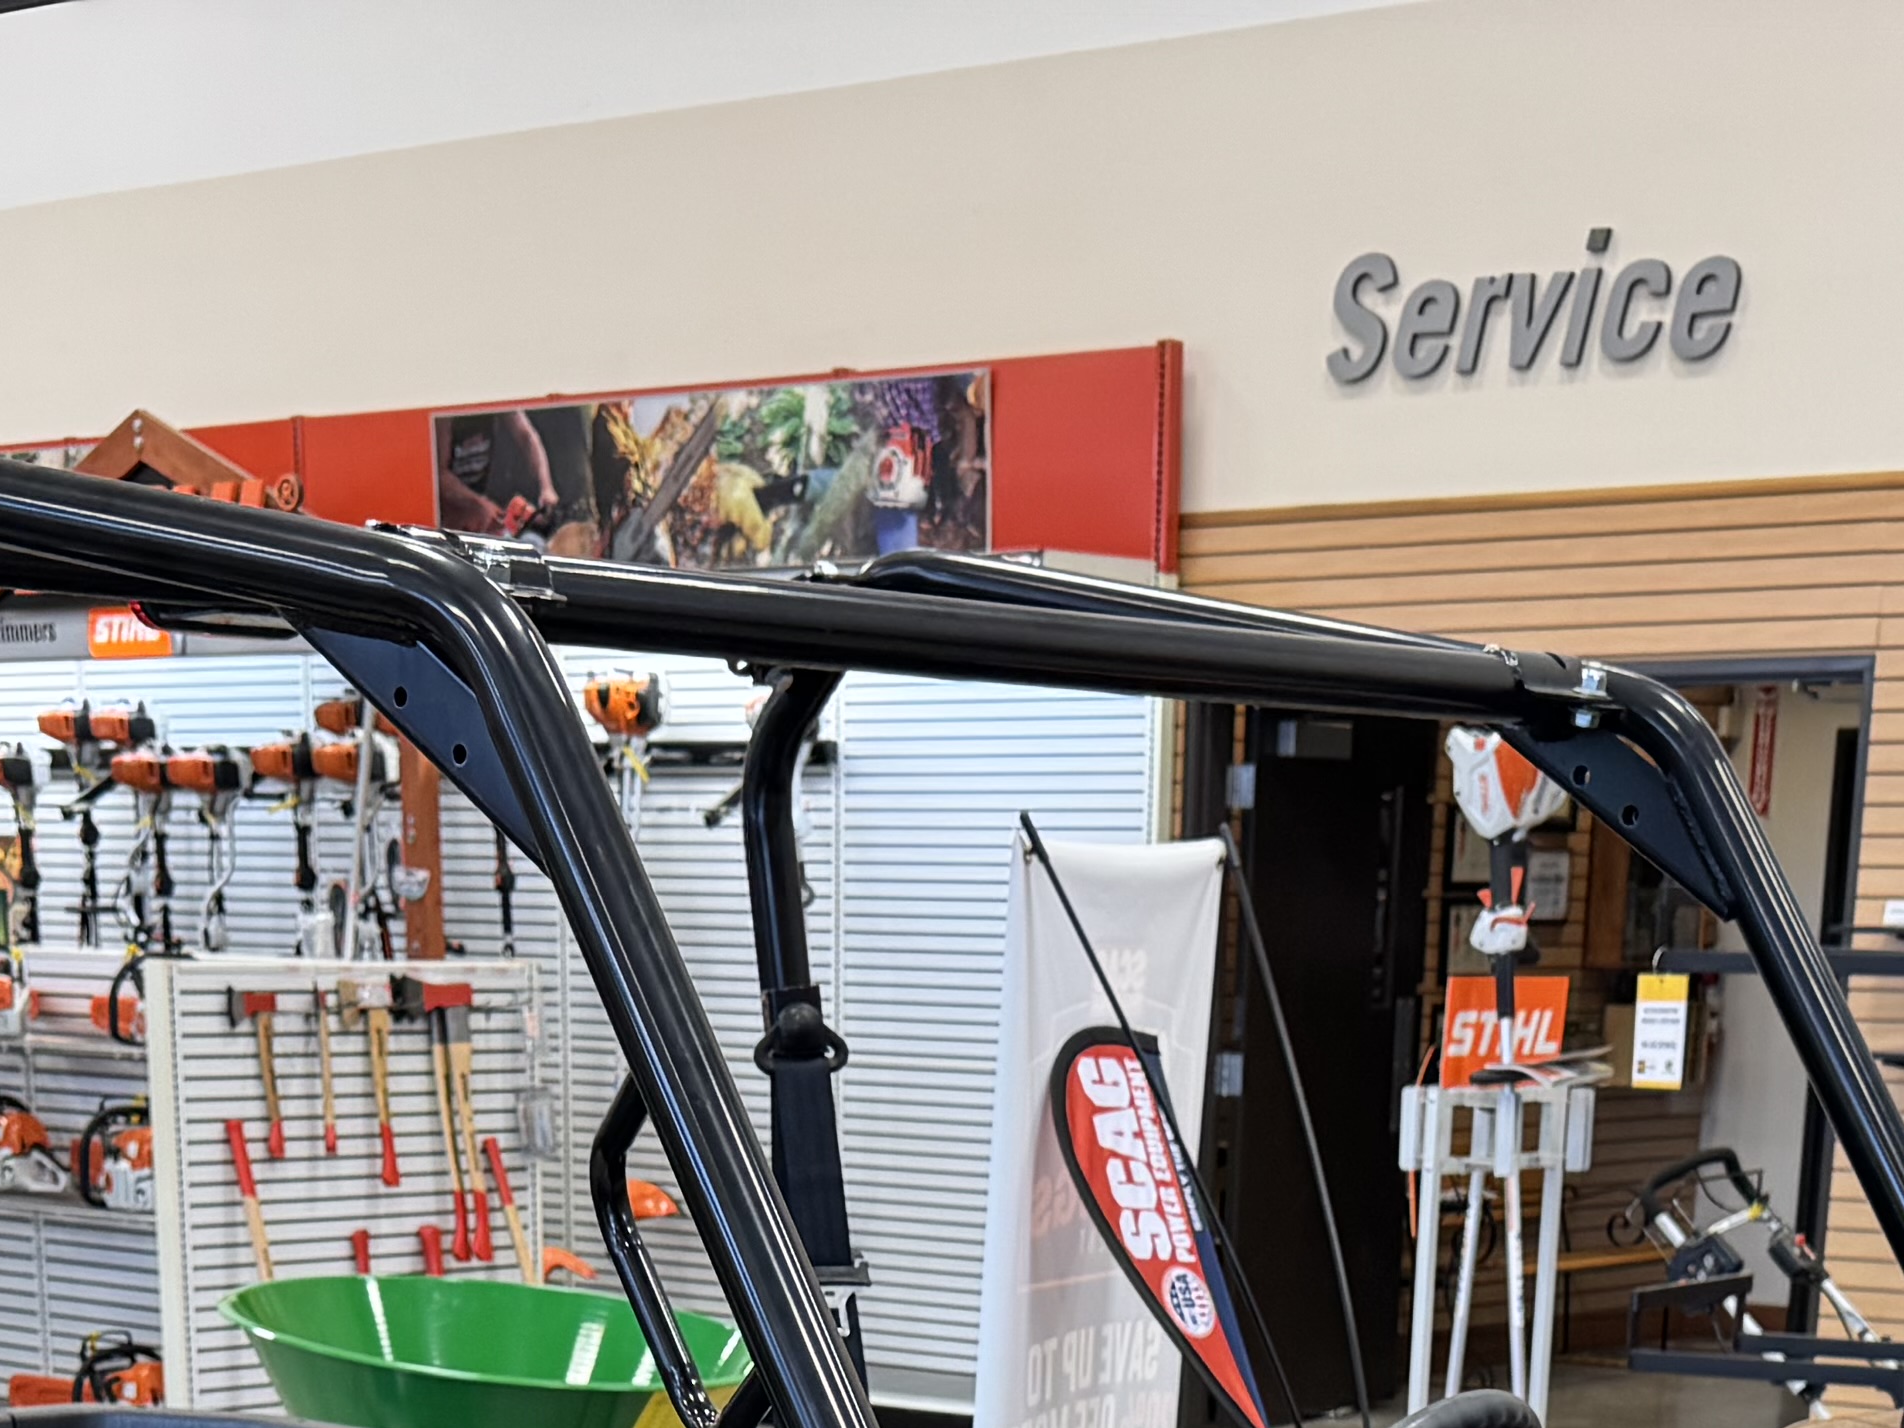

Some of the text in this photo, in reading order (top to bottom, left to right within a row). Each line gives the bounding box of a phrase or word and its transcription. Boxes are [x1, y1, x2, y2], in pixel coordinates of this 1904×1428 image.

[1326, 227, 1742, 385] Service
[1447, 1008, 1560, 1057] STHL
[1077, 1056, 1172, 1261] SCAG
[1158, 1186, 1197, 1264] POWER
[1175, 1273, 1196, 1308] USA
